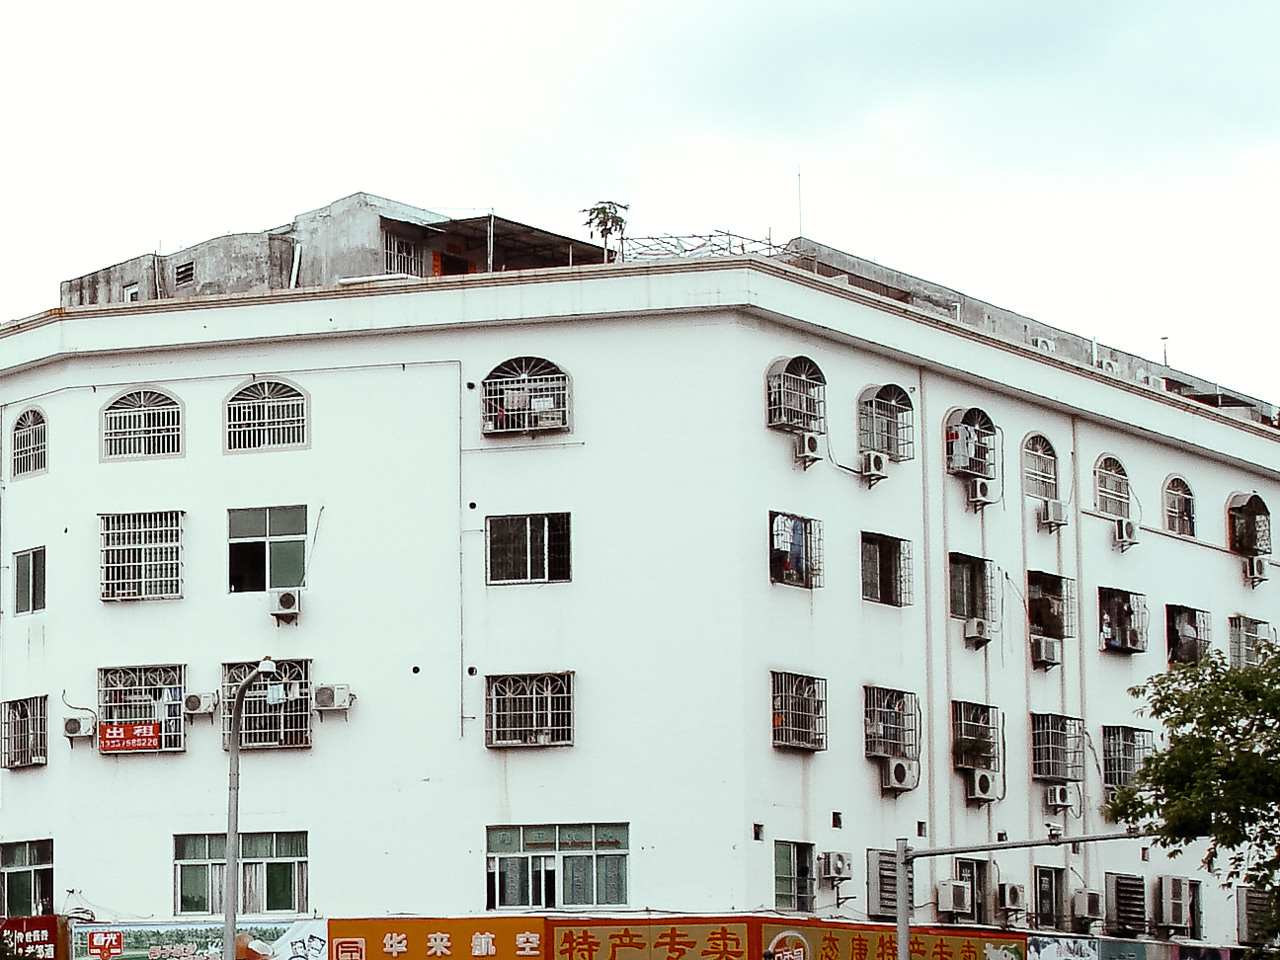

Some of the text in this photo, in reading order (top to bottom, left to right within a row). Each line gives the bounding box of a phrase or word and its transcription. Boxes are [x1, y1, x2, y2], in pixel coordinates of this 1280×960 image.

[105, 725, 155, 738] 出租
[382, 931, 541, 957] 华来航空
